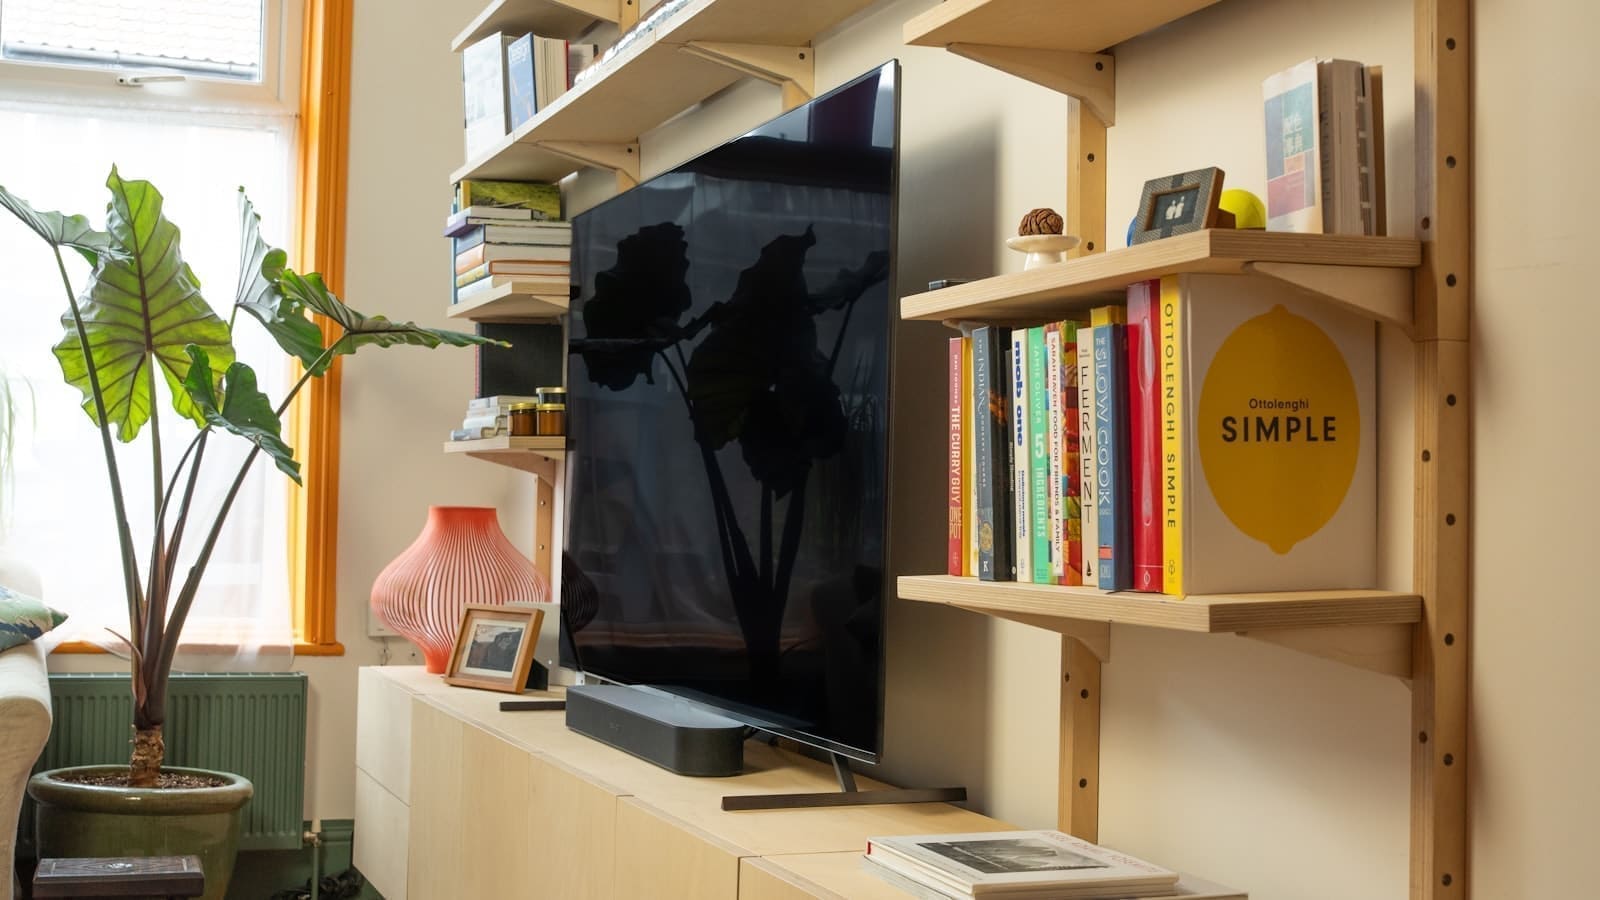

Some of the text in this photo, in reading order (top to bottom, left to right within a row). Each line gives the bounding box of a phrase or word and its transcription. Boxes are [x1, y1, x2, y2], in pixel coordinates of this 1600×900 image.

[1096, 337, 1106, 347] THE
[977, 358, 985, 415] INDIAN
[1015, 341, 1024, 447] mob one
[1095, 348, 1108, 422] SLOW
[1249, 398, 1309, 412] Ottolenghi
[951, 406, 961, 431] THE
[1033, 344, 1046, 538] JAMIE OLIVER 5 INGREDIENTS
[1081, 365, 1093, 523] FERMENT
[1164, 303, 1176, 529] OTTOLENGHI SIMPLE
[1222, 416, 1336, 442] SIMPLE
[951, 433, 961, 475] CURRY
[1097, 427, 1110, 506] COOK
[951, 477, 961, 504] GUY
